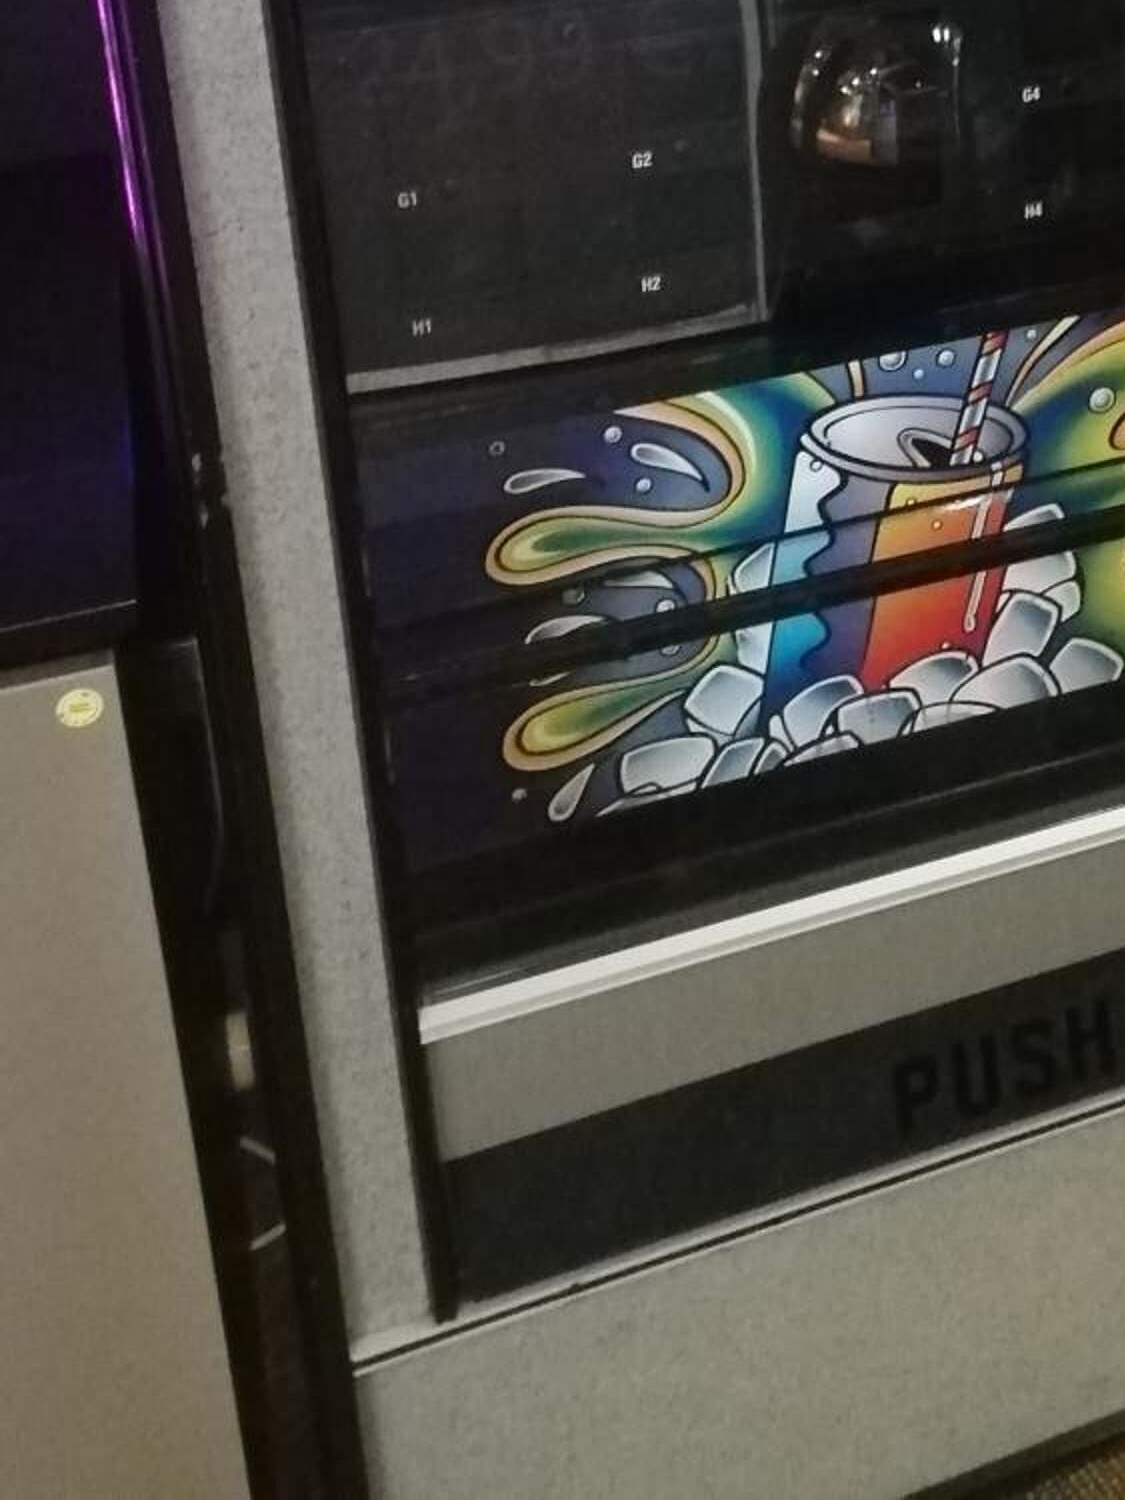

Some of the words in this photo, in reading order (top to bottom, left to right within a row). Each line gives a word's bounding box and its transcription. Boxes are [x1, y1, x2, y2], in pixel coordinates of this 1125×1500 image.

[632, 151, 653, 169] G2
[397, 191, 417, 208] G1
[641, 274, 662, 292] H2
[412, 319, 432, 336] H1
[893, 996, 1115, 1140] PUSH
